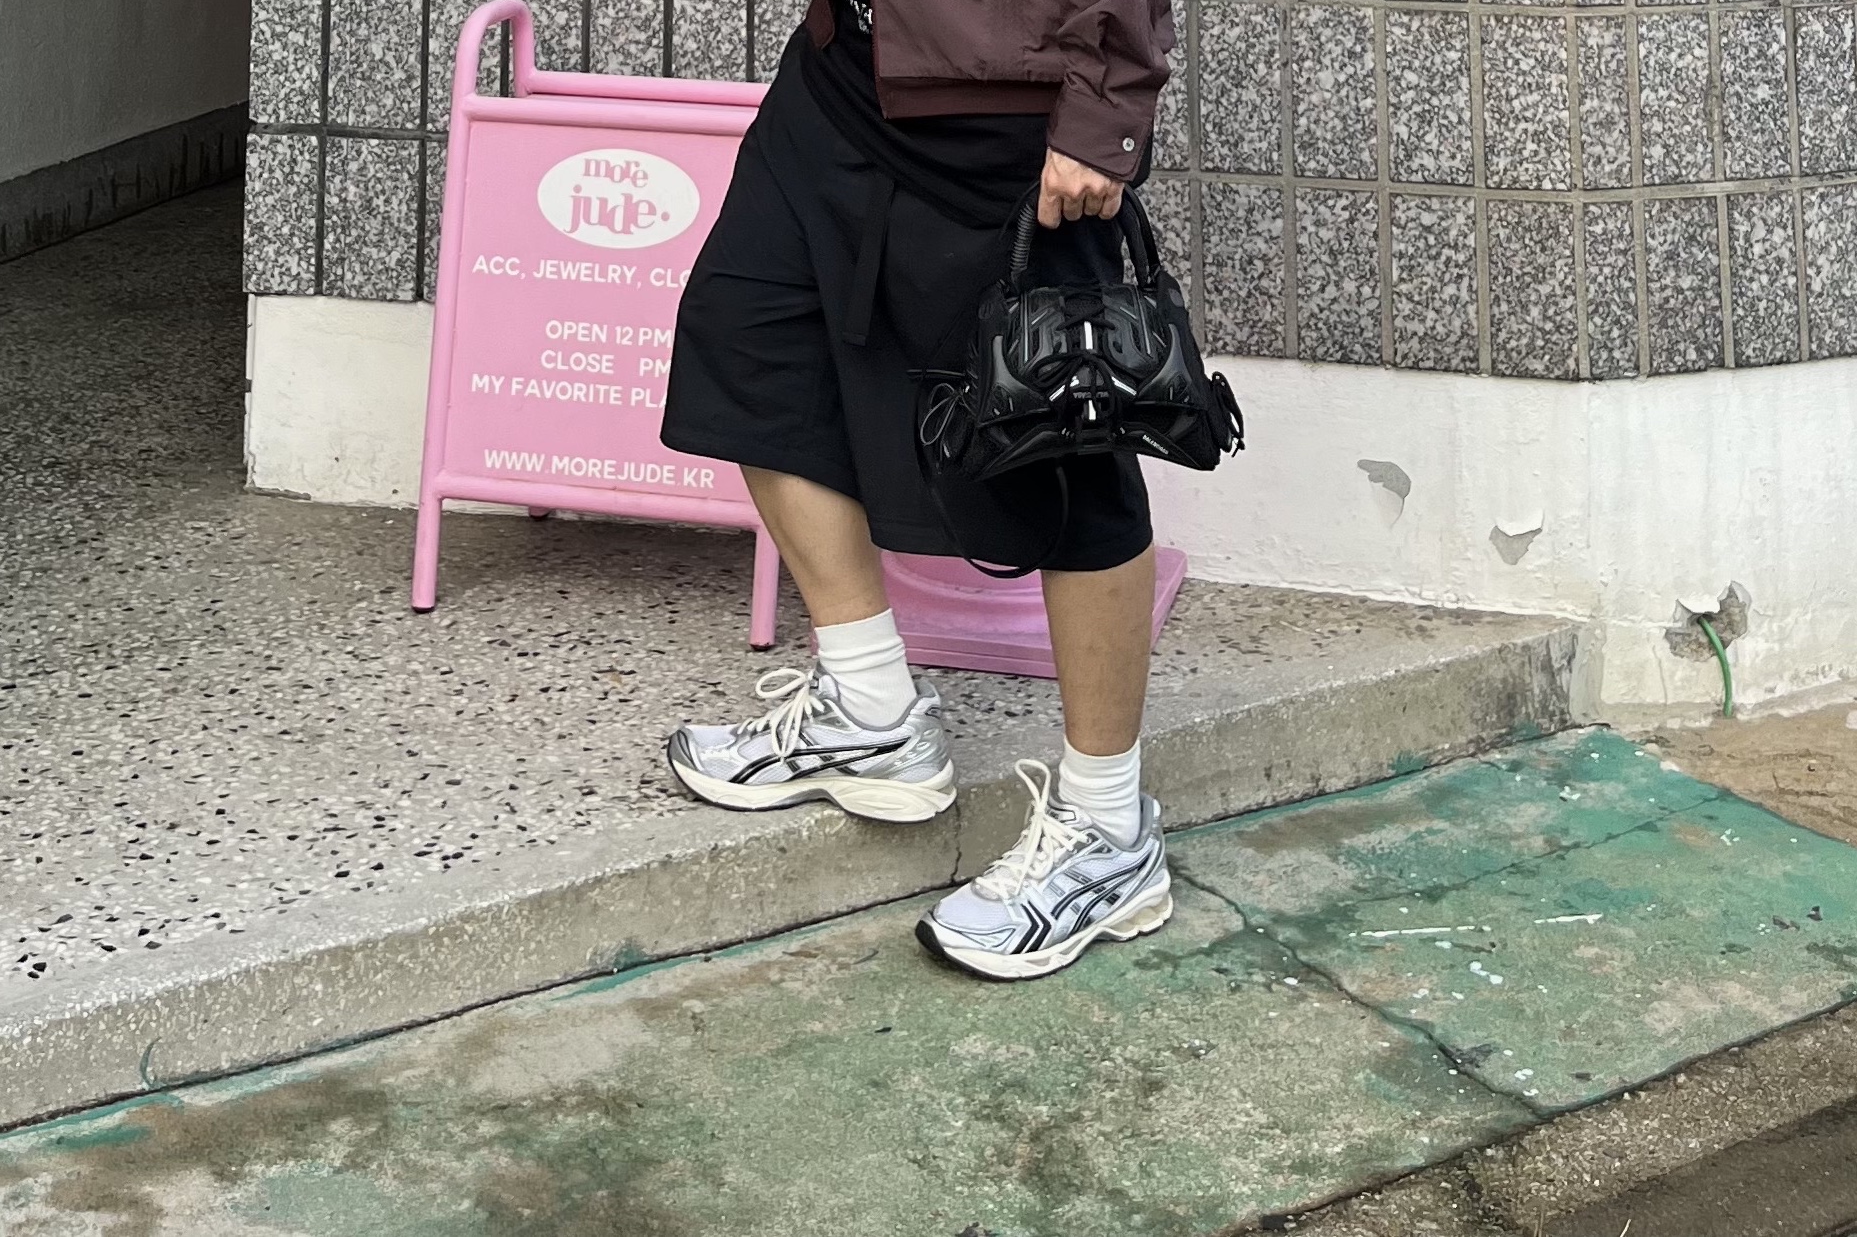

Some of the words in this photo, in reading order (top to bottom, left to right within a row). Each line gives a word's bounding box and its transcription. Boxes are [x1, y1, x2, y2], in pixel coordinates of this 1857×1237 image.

[582, 157, 649, 189] more
[563, 184, 671, 235] jude.
[472, 255, 526, 279] ACC,
[532, 259, 642, 289] JEWELRY,
[545, 320, 607, 344] OPEN
[614, 325, 634, 346] 12
[637, 327, 673, 348] PM
[540, 350, 615, 374] CLOSE
[639, 357, 672, 379] PM
[471, 374, 505, 394] MY
[511, 376, 623, 405] FAVORITE
